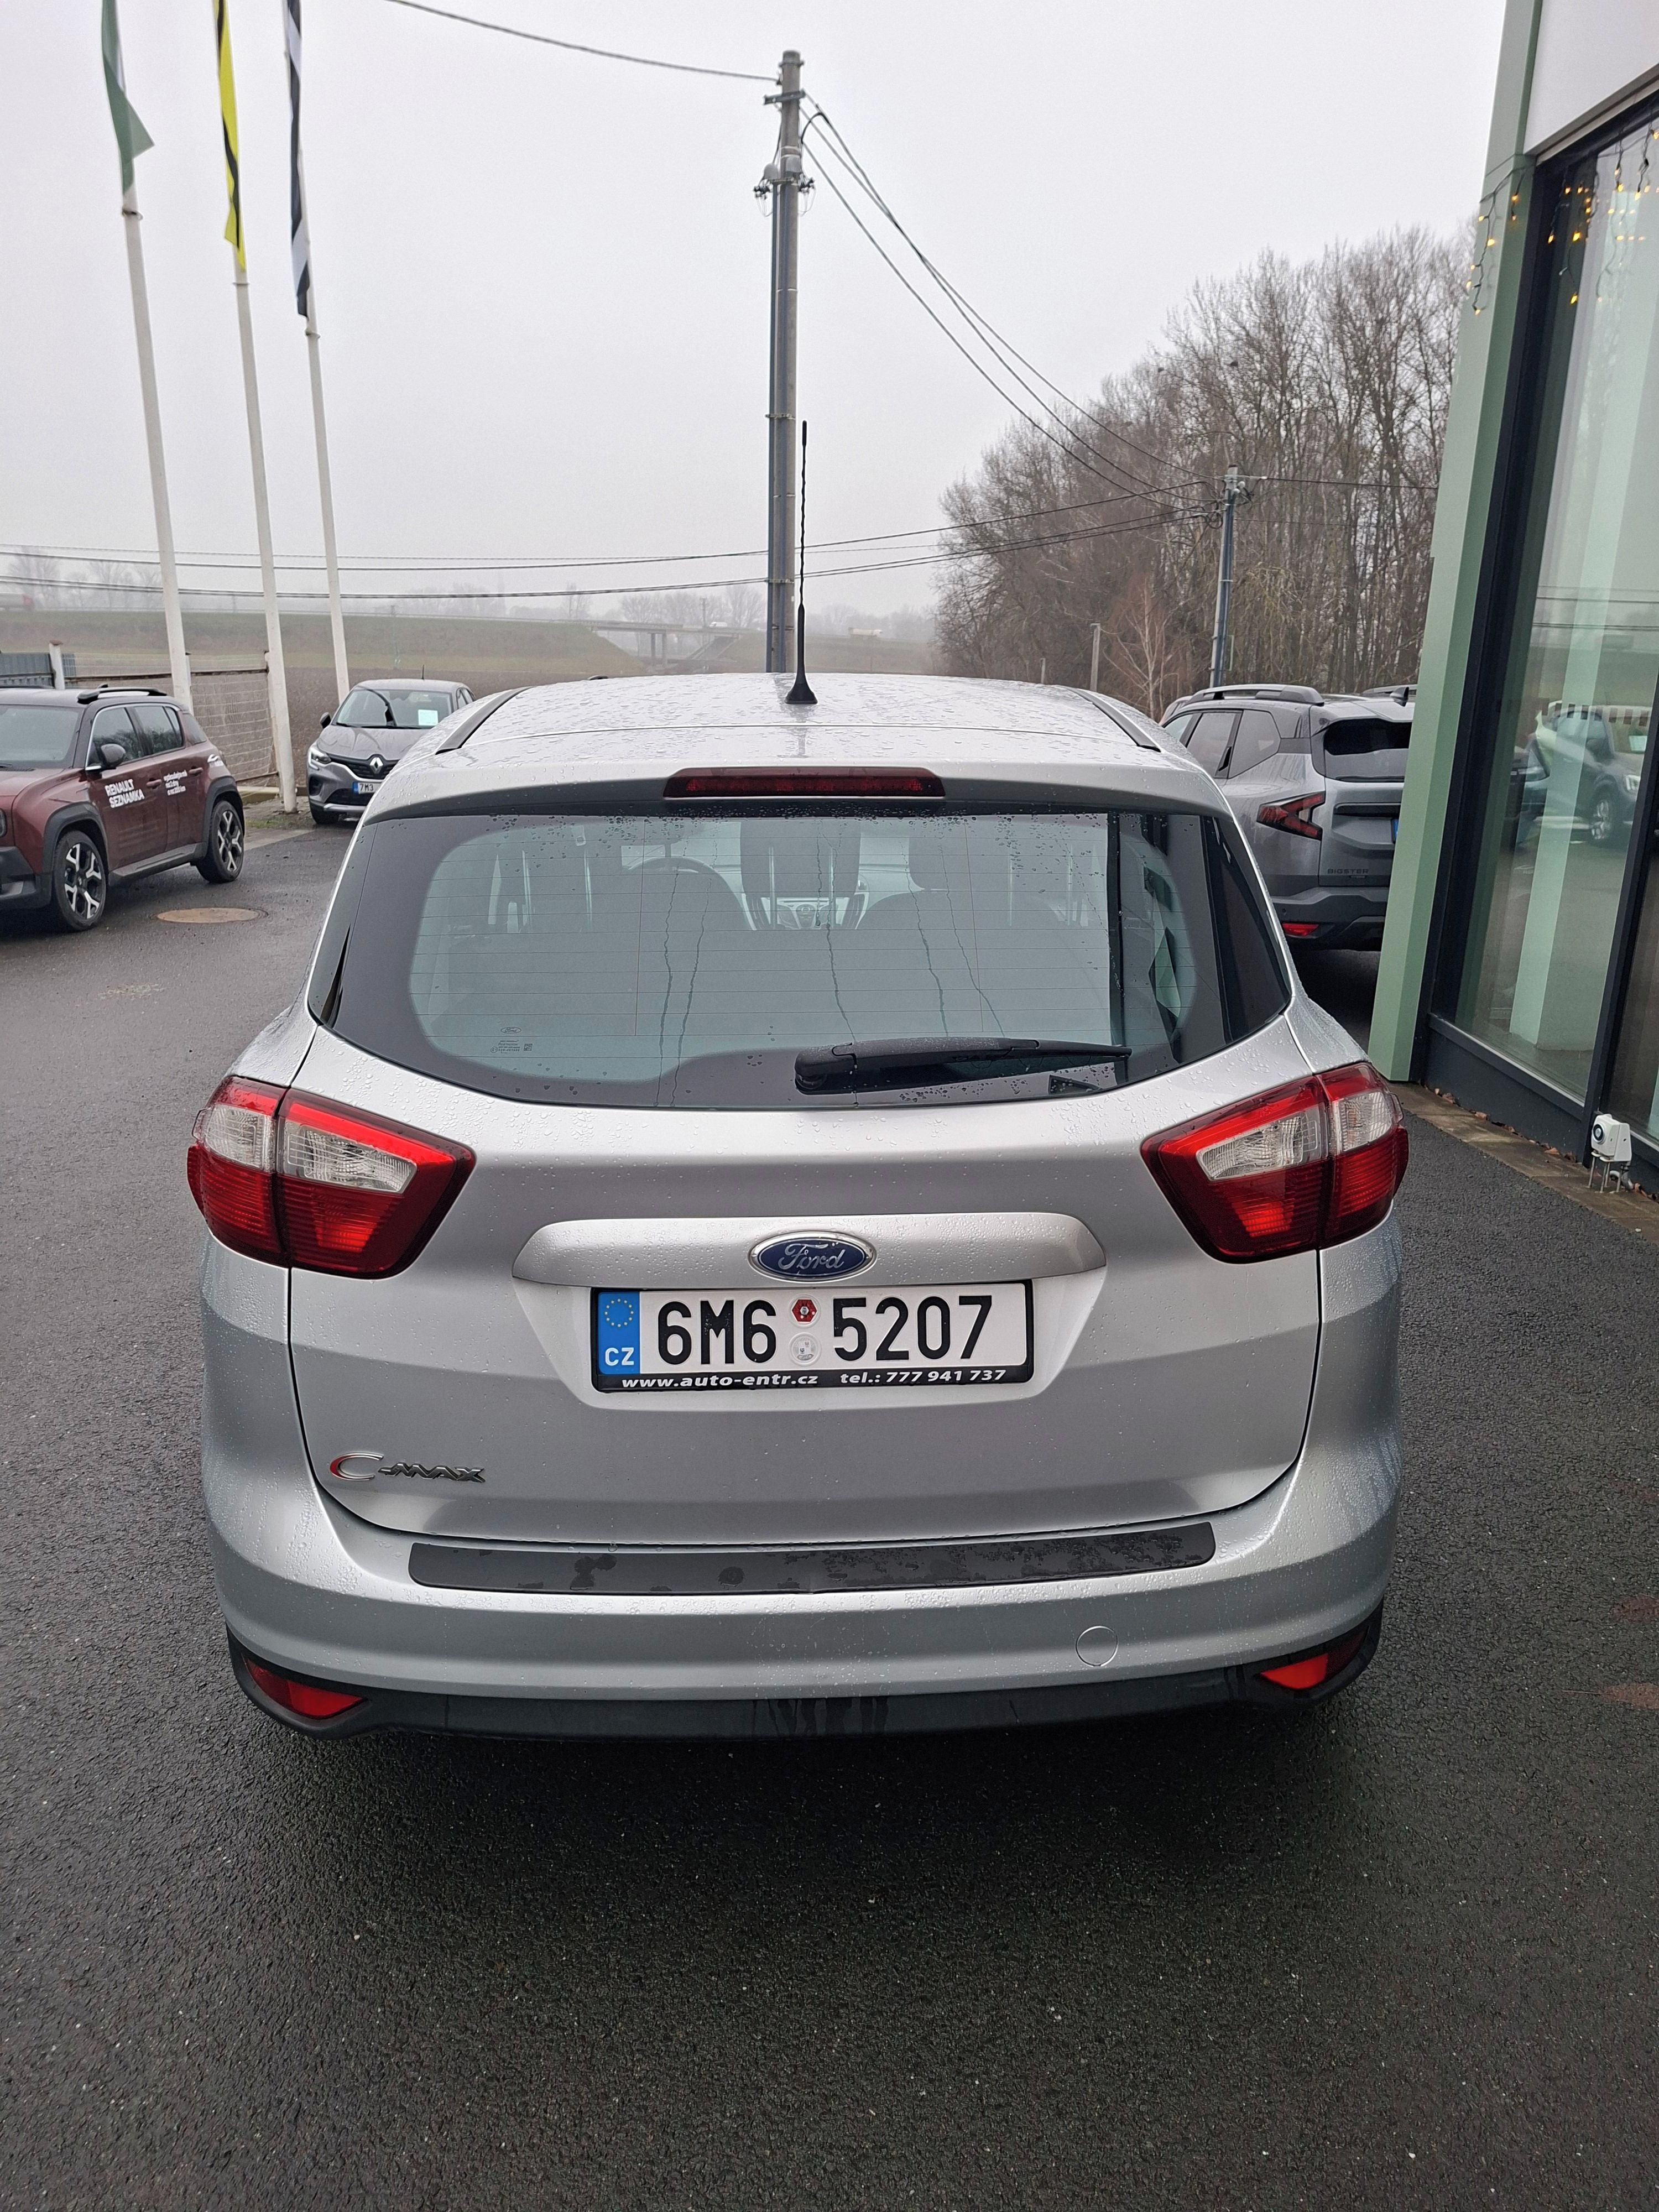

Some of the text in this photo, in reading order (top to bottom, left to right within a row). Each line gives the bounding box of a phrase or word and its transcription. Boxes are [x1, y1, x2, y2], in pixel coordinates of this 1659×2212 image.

[105, 779, 134, 796] RENAULT
[109, 789, 145, 808] SEZNAMKA
[778, 1243, 846, 1270] Ford
[658, 1295, 993, 1365] 6M6 5207
[604, 1347, 635, 1366] CZ
[622, 1370, 1006, 1387] www.auto-entr.cz tel.: 777 941 737
